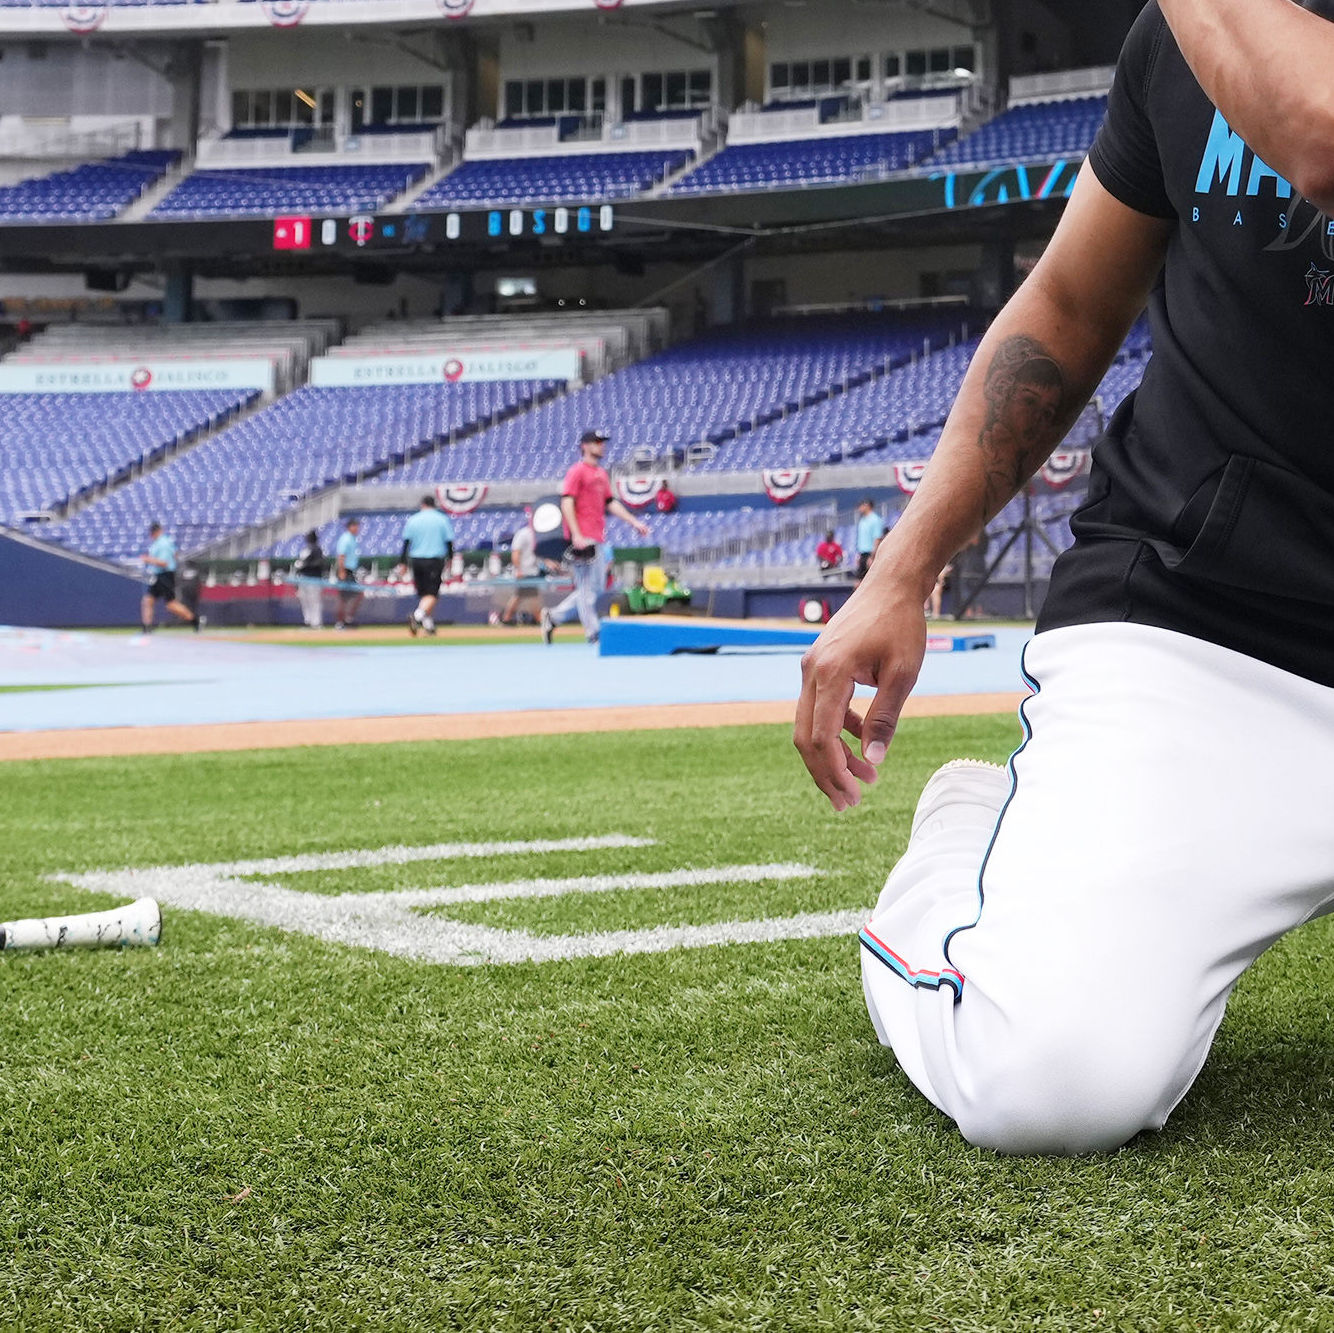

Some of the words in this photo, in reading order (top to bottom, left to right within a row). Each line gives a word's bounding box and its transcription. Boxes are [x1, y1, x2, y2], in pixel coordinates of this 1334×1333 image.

[322, 219, 337, 246] 0
[446, 213, 460, 239] 0
[509, 209, 523, 236] 0
[532, 209, 546, 234] S
[555, 207, 568, 233] 0
[600, 205, 613, 231] 0
